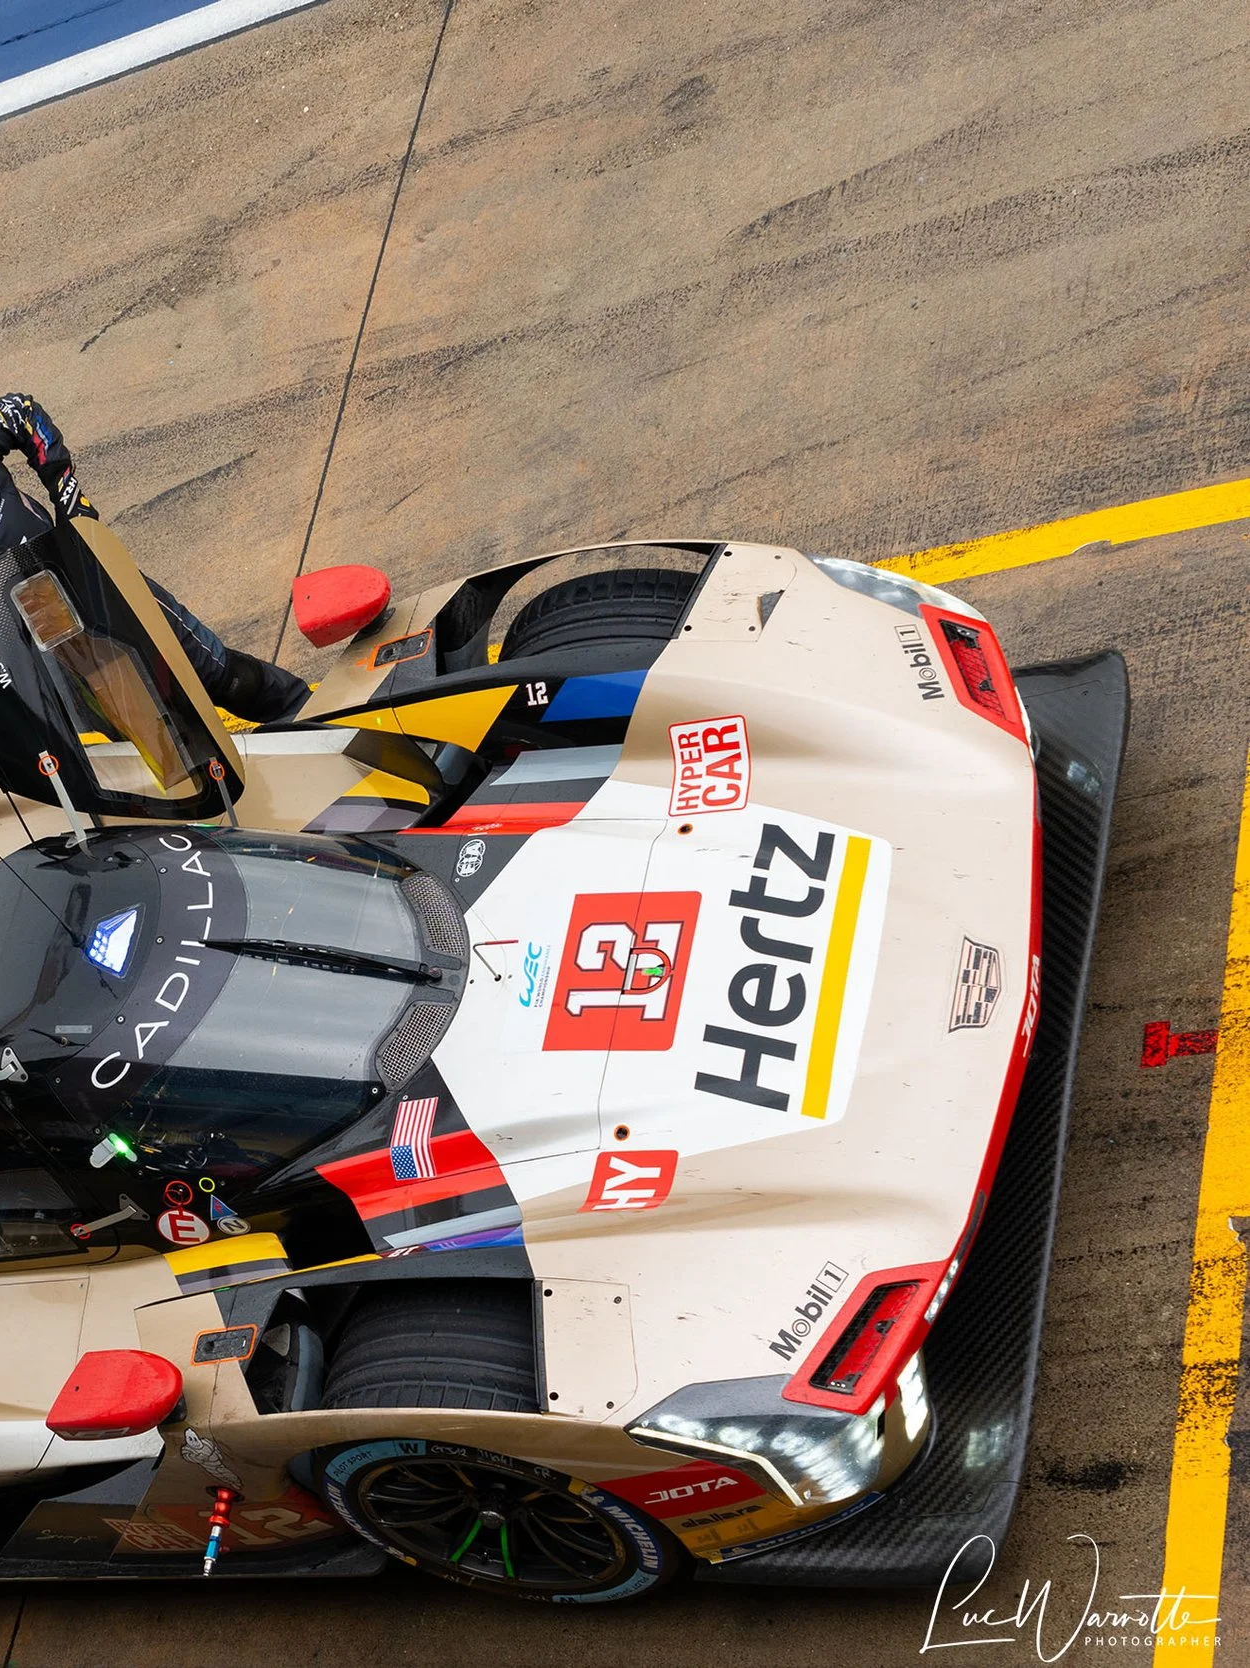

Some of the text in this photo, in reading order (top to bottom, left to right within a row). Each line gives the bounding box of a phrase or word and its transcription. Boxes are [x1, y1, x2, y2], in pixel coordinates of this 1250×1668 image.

[525, 681, 549, 706] 12
[902, 643, 945, 701] Mobil
[676, 730, 703, 811] HYPER
[702, 722, 742, 807] CAR
[88, 833, 216, 1091] CADILLAC
[519, 941, 543, 1008] WEC
[564, 920, 685, 1023] 12
[694, 823, 835, 1112] Hertz
[1021, 953, 1040, 1058] JOTA
[592, 1156, 662, 1211] HY
[167, 1213, 201, 1242] E
[769, 1284, 833, 1361] Mobil
[398, 1442, 419, 1454] W
[644, 1476, 739, 1505] JOTA
[680, 1504, 767, 1530] dallara
[604, 1506, 659, 1569] MICHELIN
